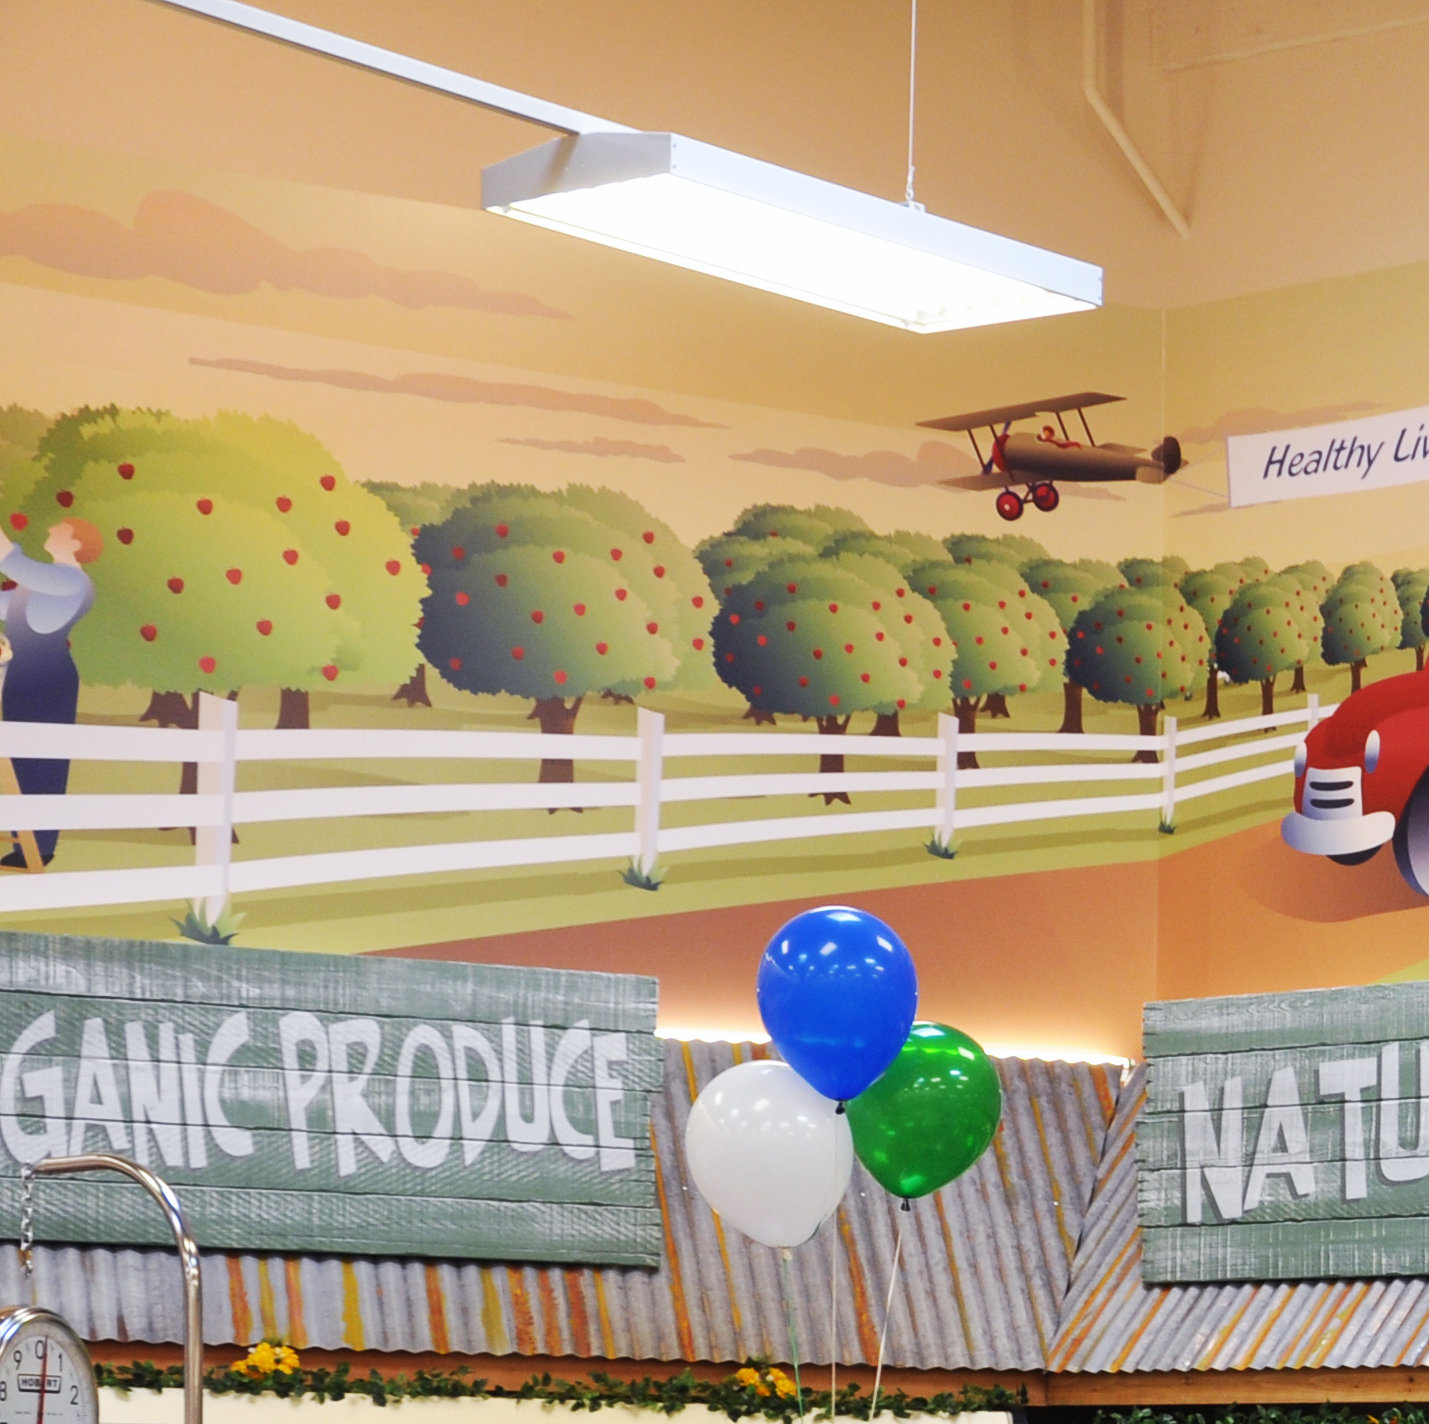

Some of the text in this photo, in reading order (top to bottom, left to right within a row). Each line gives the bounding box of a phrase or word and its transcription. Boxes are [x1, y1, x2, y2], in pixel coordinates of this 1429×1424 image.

[1262, 438, 1385, 480] Healthy
[279, 1010, 636, 1176] PRODUCE
[35, 1340, 44, 1360] 0
[70, 1385, 79, 1405] 2
